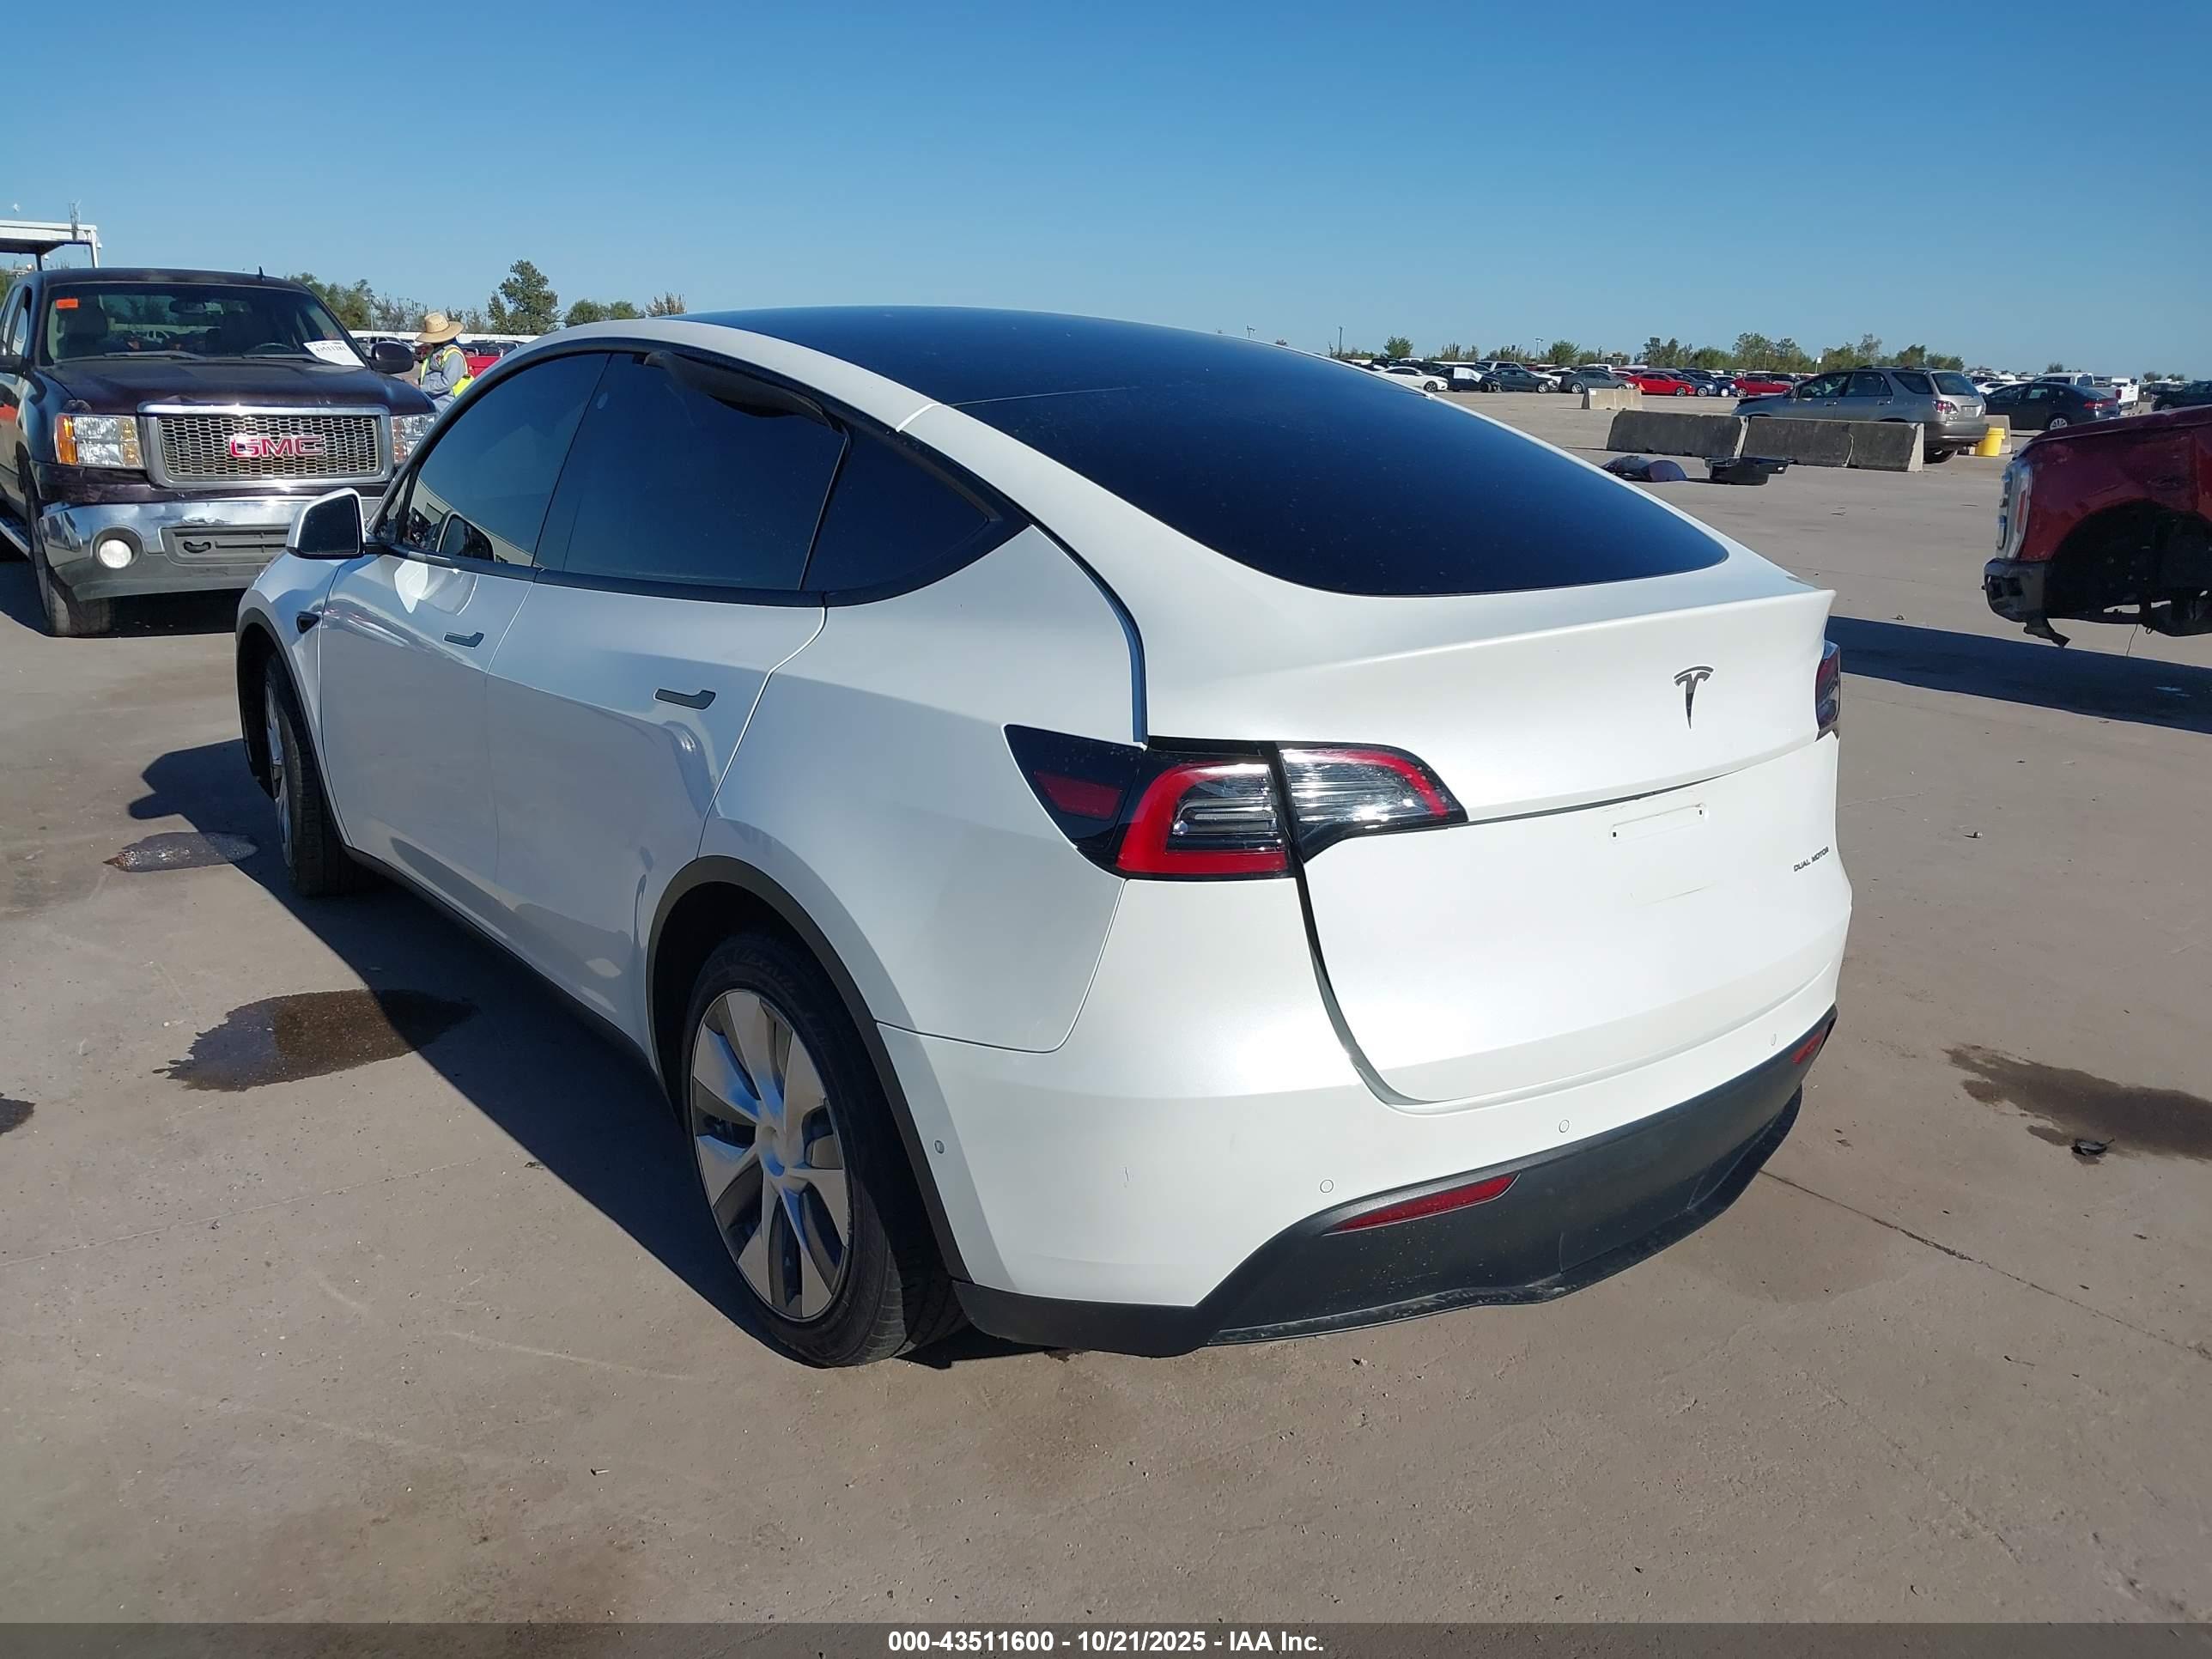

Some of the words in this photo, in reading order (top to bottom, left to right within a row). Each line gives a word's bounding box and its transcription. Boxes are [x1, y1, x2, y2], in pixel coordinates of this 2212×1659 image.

[228, 435, 325, 458] GMC
[1793, 859, 1811, 872] DUAL
[1811, 846, 1829, 863] MOTOR
